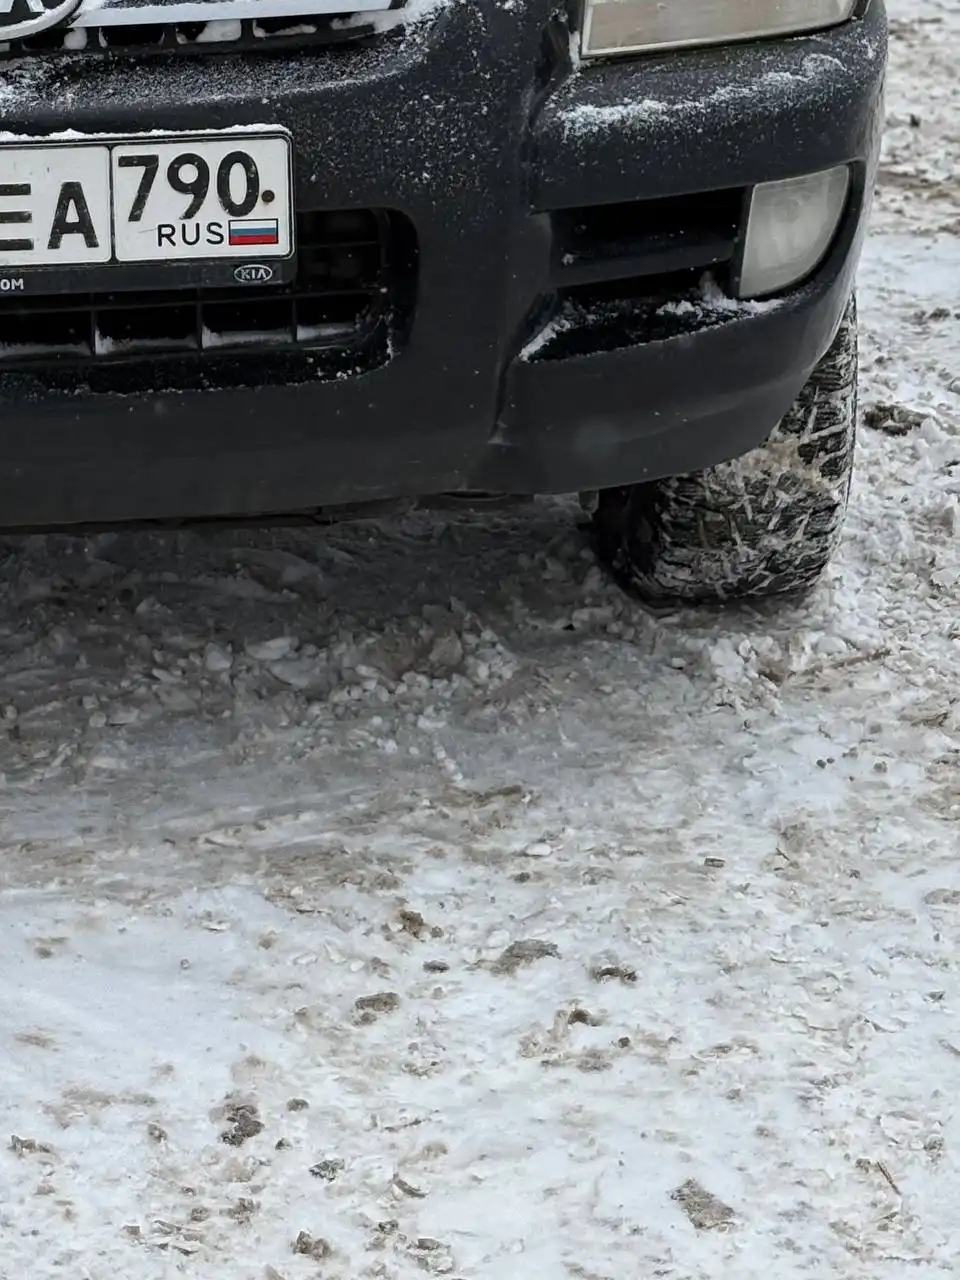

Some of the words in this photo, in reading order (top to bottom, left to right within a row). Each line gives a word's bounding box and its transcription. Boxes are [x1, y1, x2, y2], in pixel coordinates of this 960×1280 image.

[117, 150, 260, 222] 790
[157, 222, 225, 247] RUS
[239, 267, 268, 280] KIA
